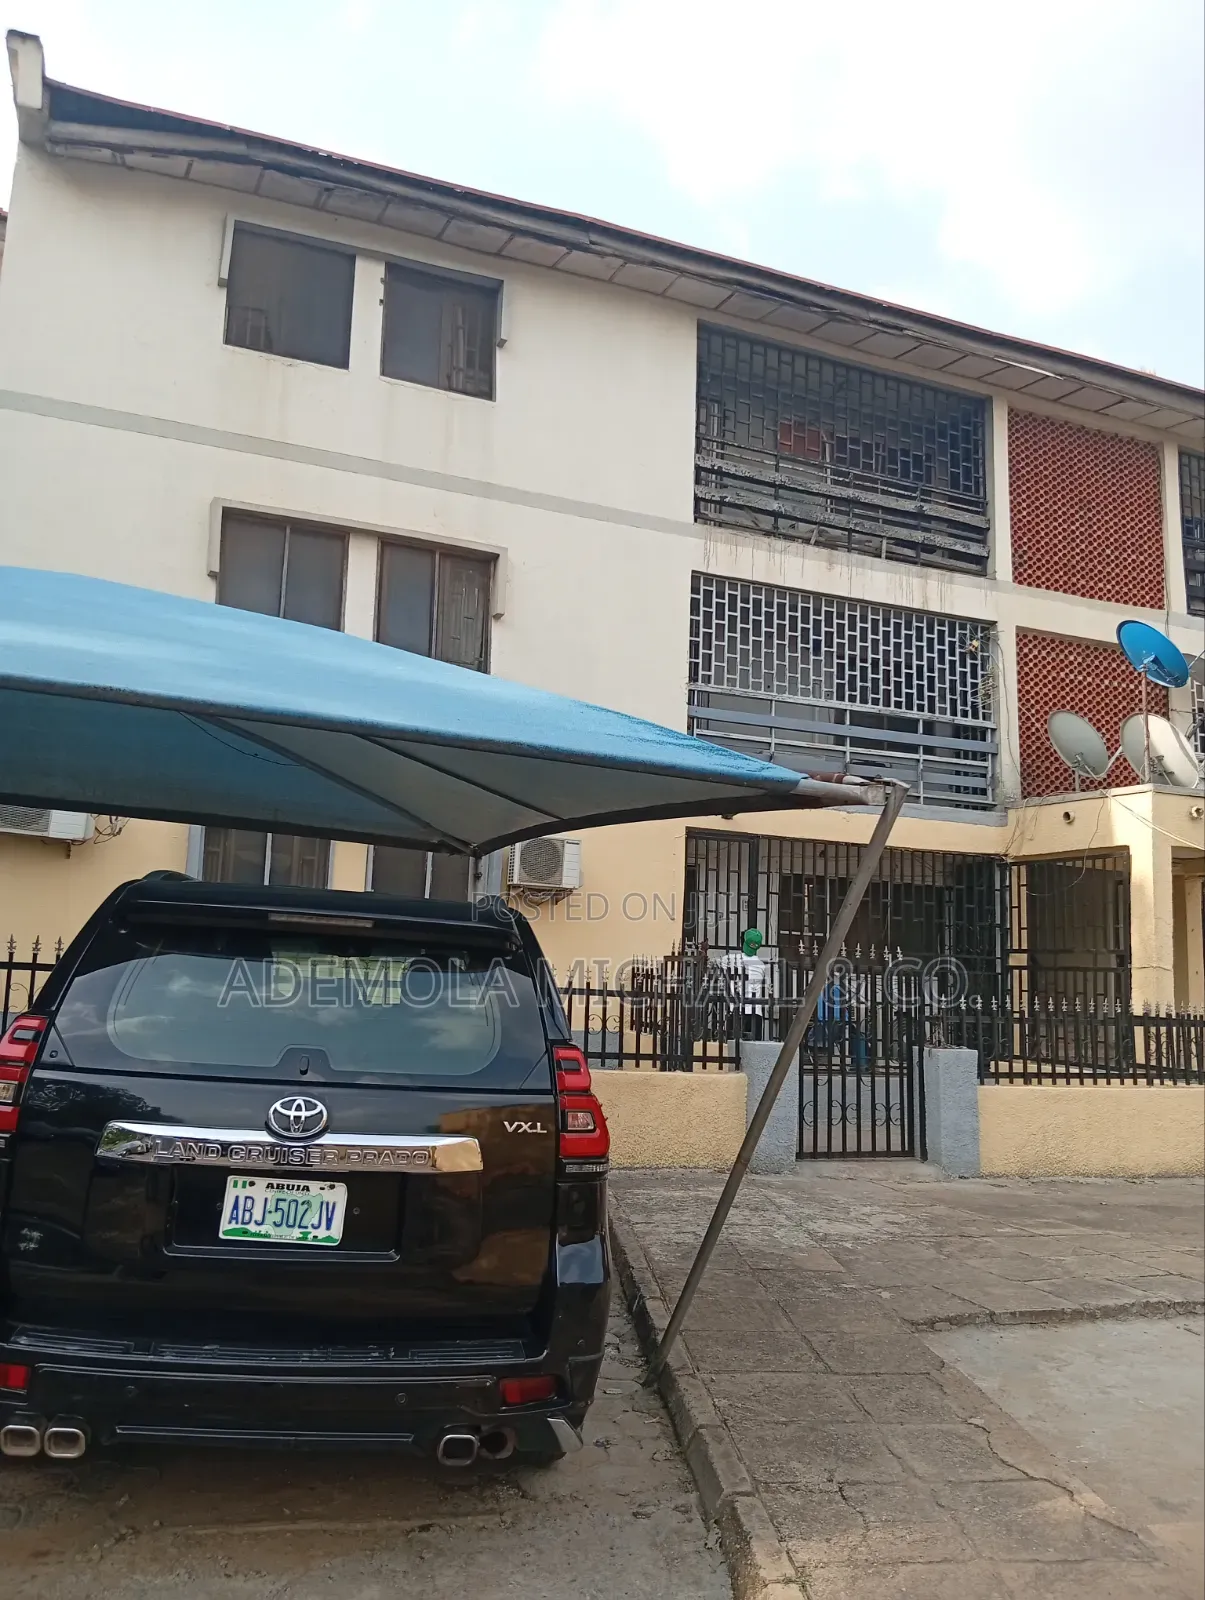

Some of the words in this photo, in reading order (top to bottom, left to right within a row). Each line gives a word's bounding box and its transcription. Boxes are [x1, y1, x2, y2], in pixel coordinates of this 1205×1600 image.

[503, 1120, 547, 1133] VXL
[154, 1138, 222, 1161] LAND
[228, 1144, 339, 1165] CRUISER
[345, 1149, 429, 1167] PRADO
[265, 1182, 310, 1192] ABUJA
